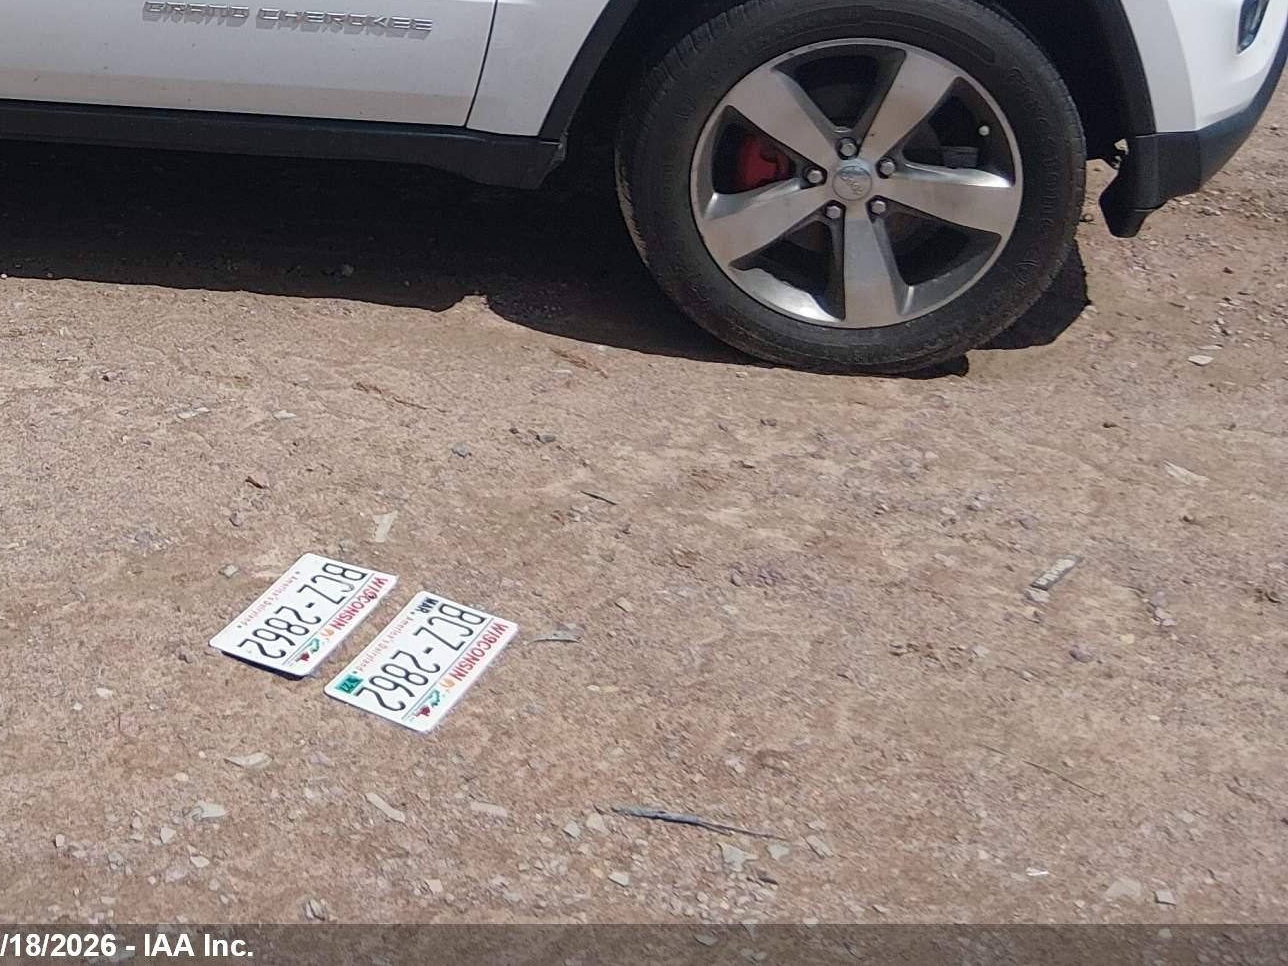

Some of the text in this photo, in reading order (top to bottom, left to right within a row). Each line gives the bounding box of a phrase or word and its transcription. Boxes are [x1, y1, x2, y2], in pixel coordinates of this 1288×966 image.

[144, 1, 433, 32] GRAND CHEROKEE
[237, 562, 368, 659] BCZ-2862
[331, 577, 389, 631] WISCONSIN
[354, 603, 487, 711] BCZ-2862
[449, 622, 509, 681] WISCONSIN
